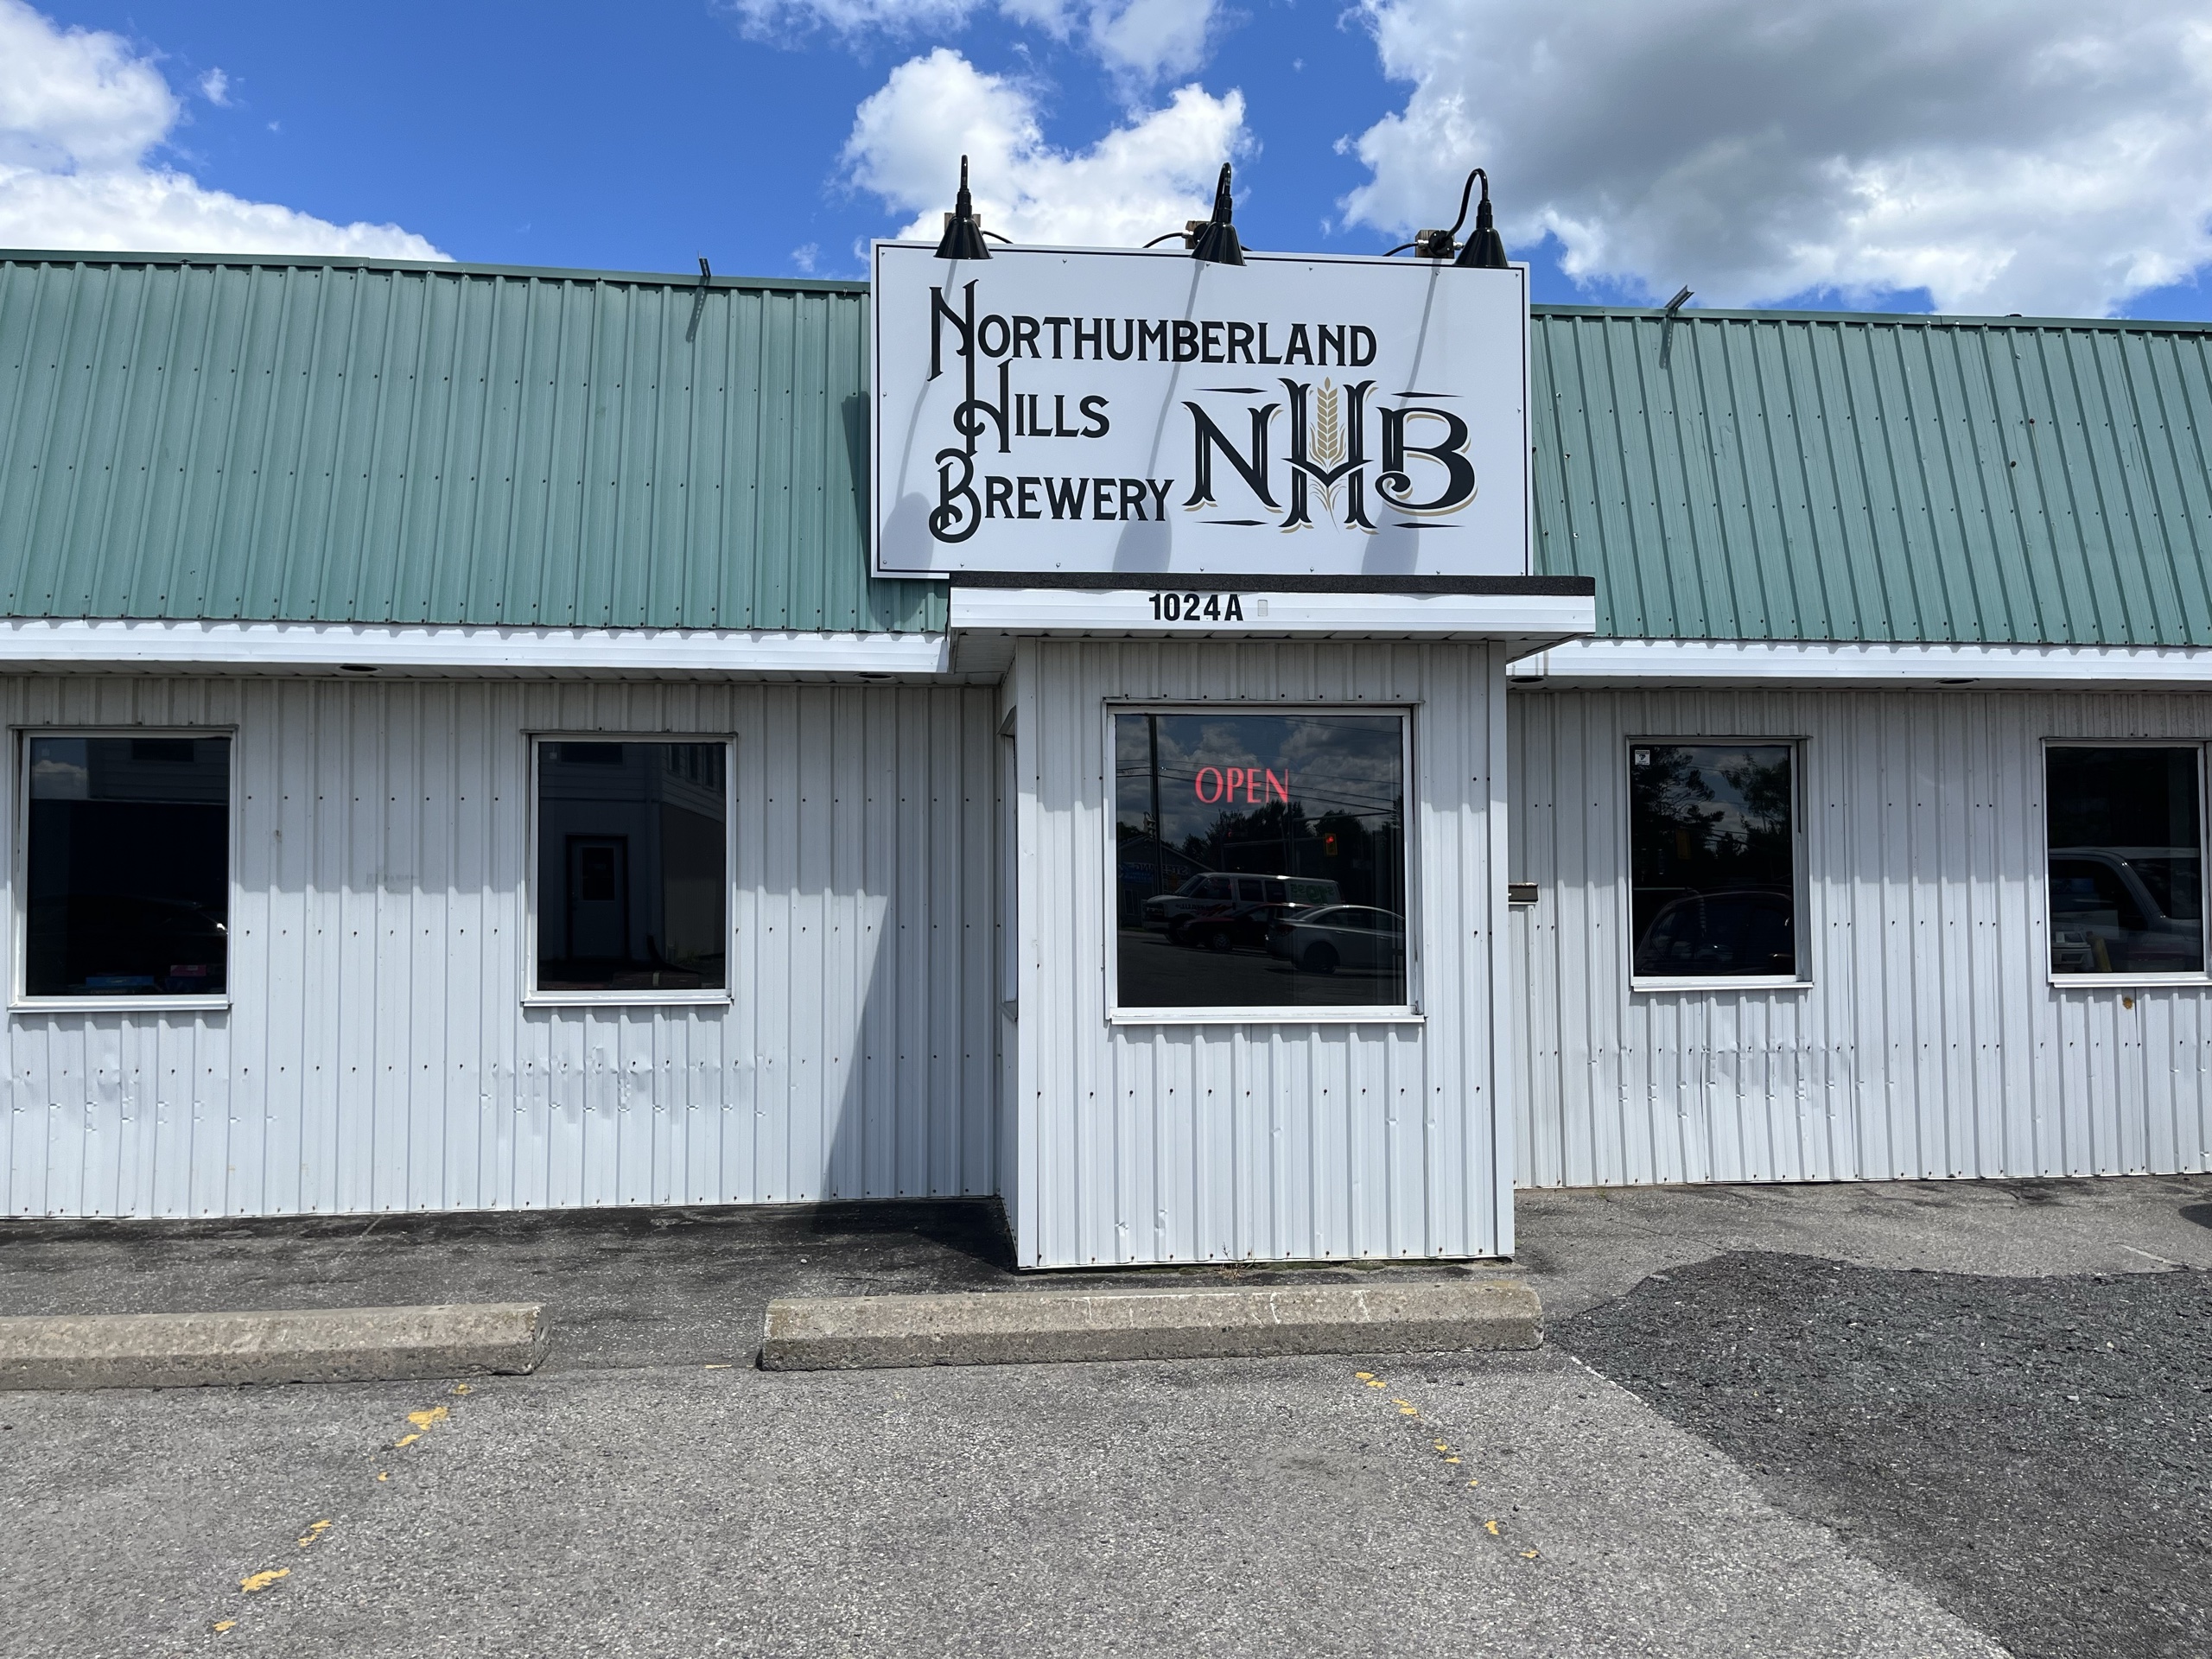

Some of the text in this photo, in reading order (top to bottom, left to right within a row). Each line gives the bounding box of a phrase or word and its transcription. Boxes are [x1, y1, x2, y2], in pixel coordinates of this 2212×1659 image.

[929, 278, 1377, 382] NORTHUMBERLAND
[953, 359, 1110, 454] HILLS
[929, 448, 1175, 543] BREWERY
[1181, 378, 1478, 535] NHB
[1148, 593, 1244, 621] 1024A
[1194, 766, 1289, 804] OPEN
